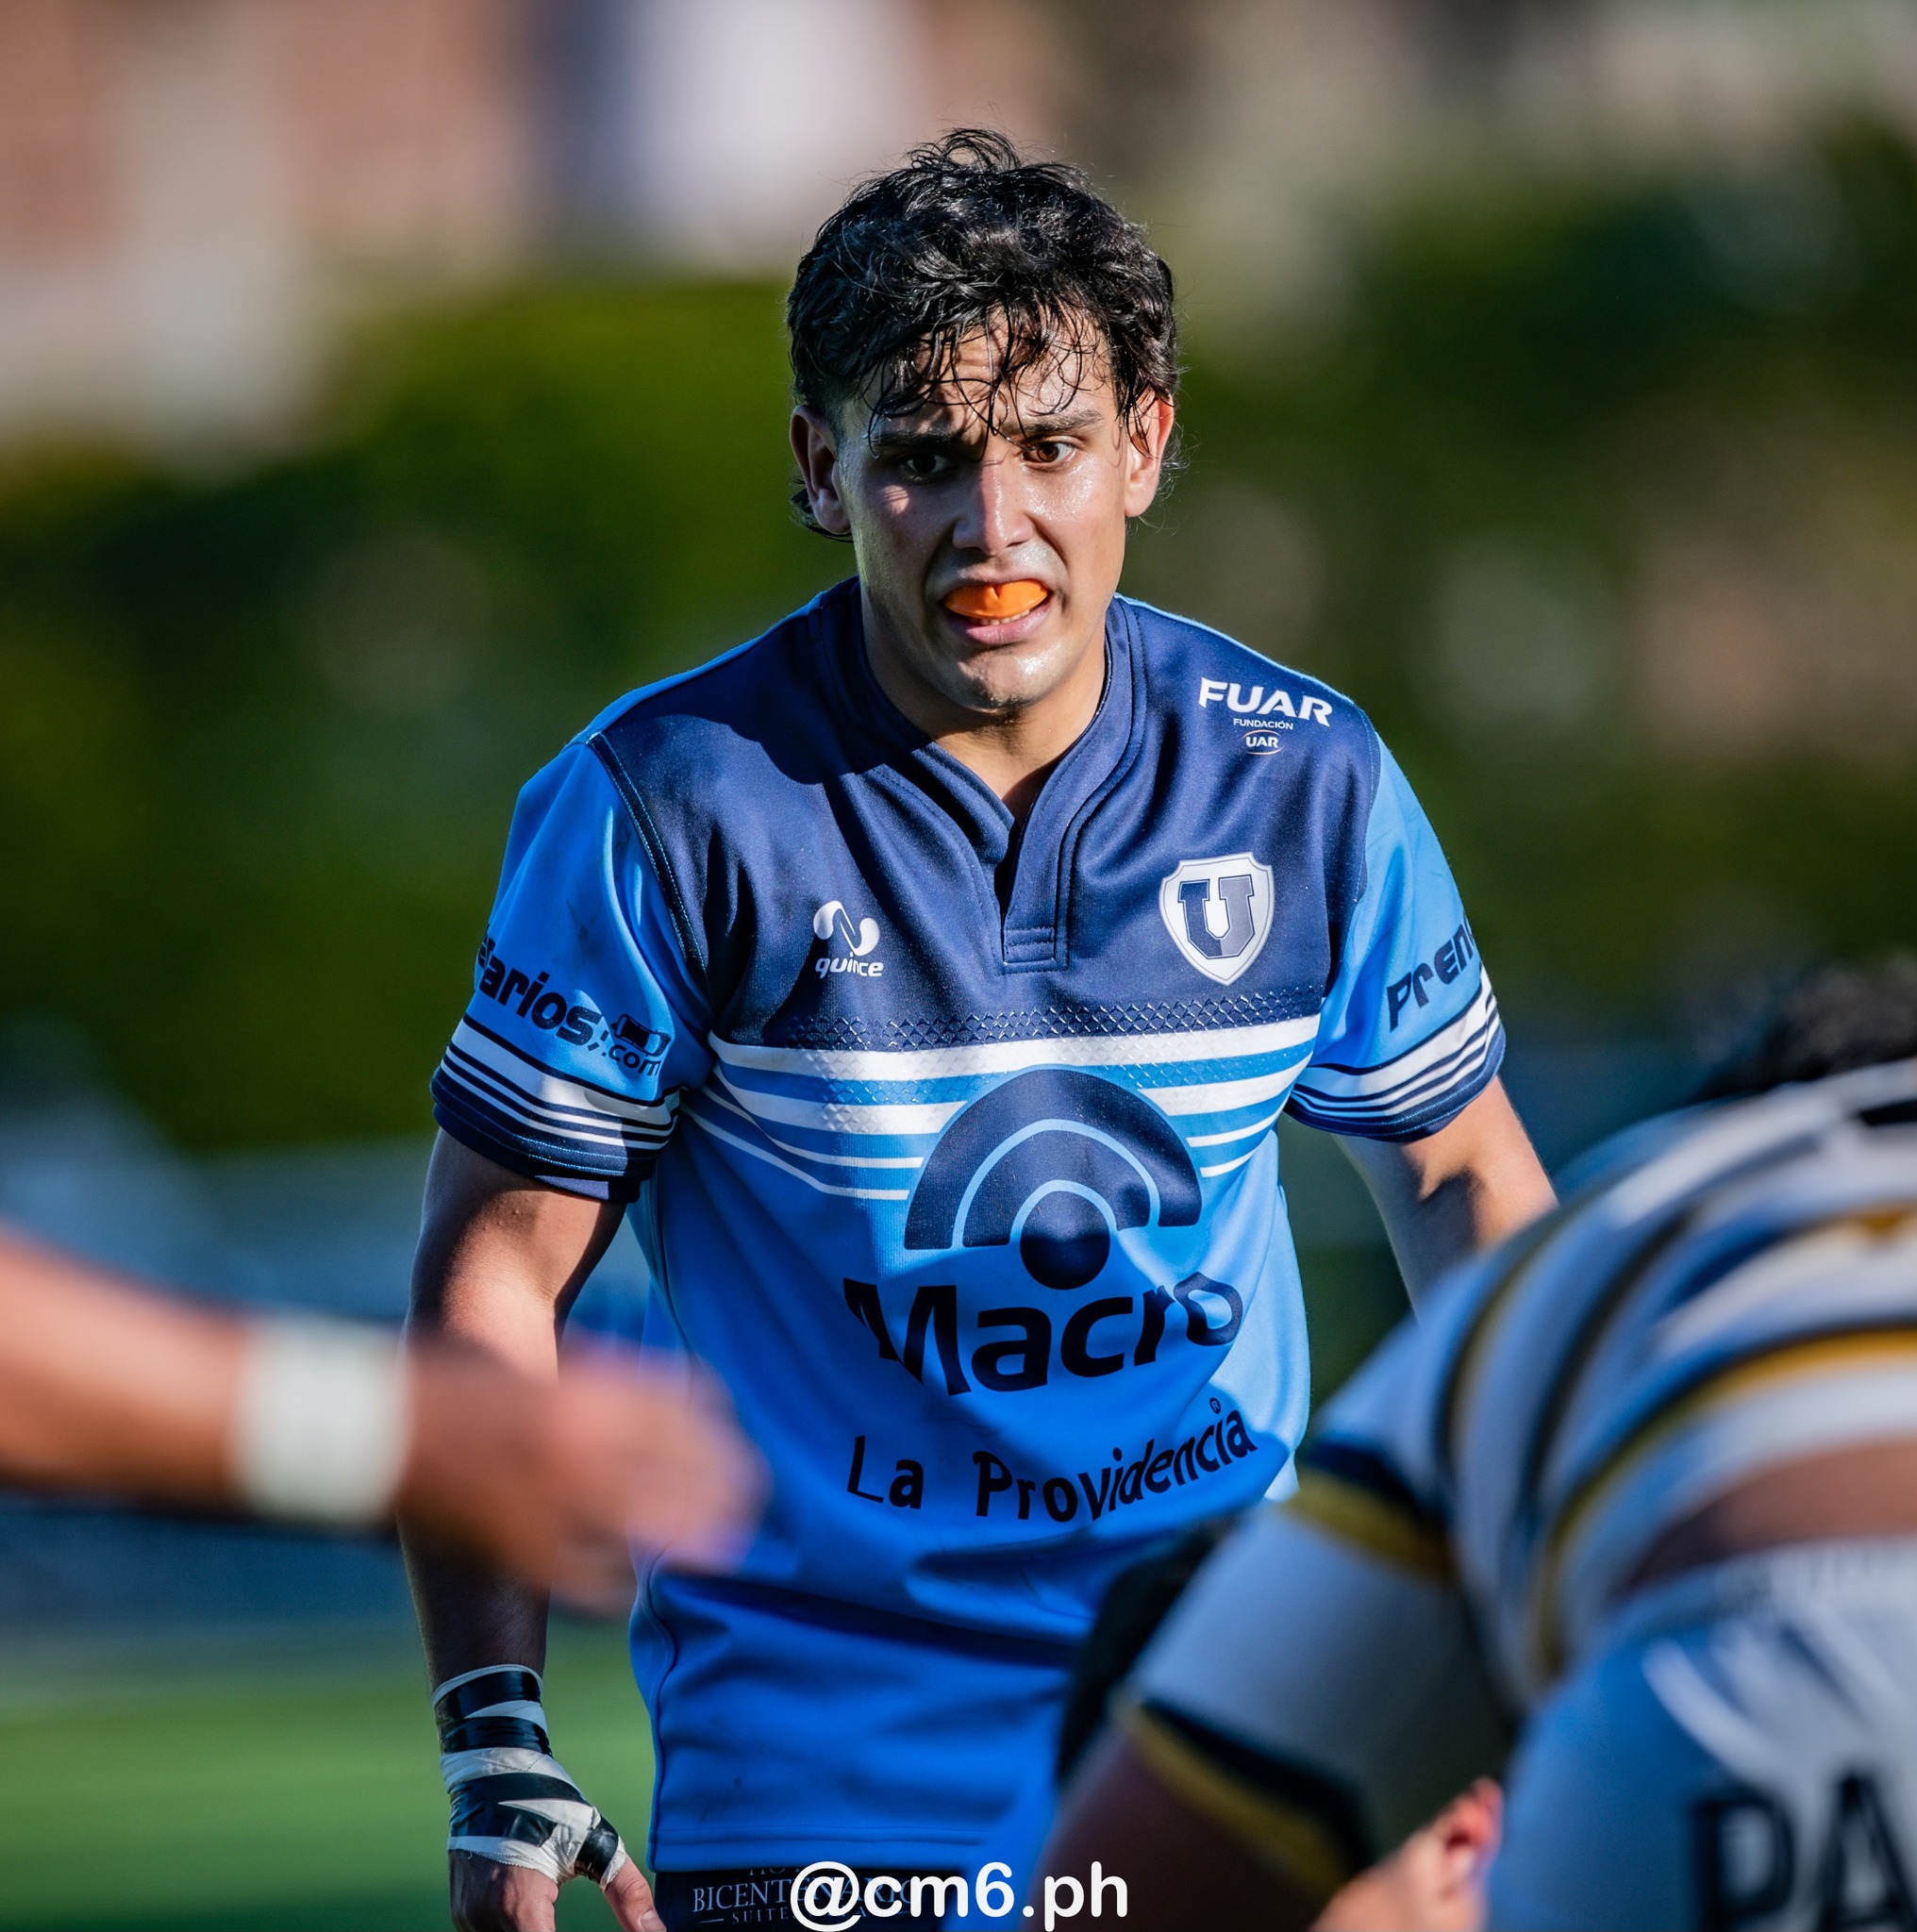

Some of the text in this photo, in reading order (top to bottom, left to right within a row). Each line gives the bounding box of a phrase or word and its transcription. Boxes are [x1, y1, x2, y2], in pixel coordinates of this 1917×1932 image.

[1198, 676, 1333, 727] FUAR
[1233, 718, 1294, 731] FUNDACIÓN
[1245, 737, 1279, 749] UAR
[1177, 874, 1256, 960] U
[814, 950, 885, 979] quince
[842, 1271, 1244, 1396] Macro
[847, 1435, 925, 1509] La
[732, 1906, 796, 1925] SUITE
